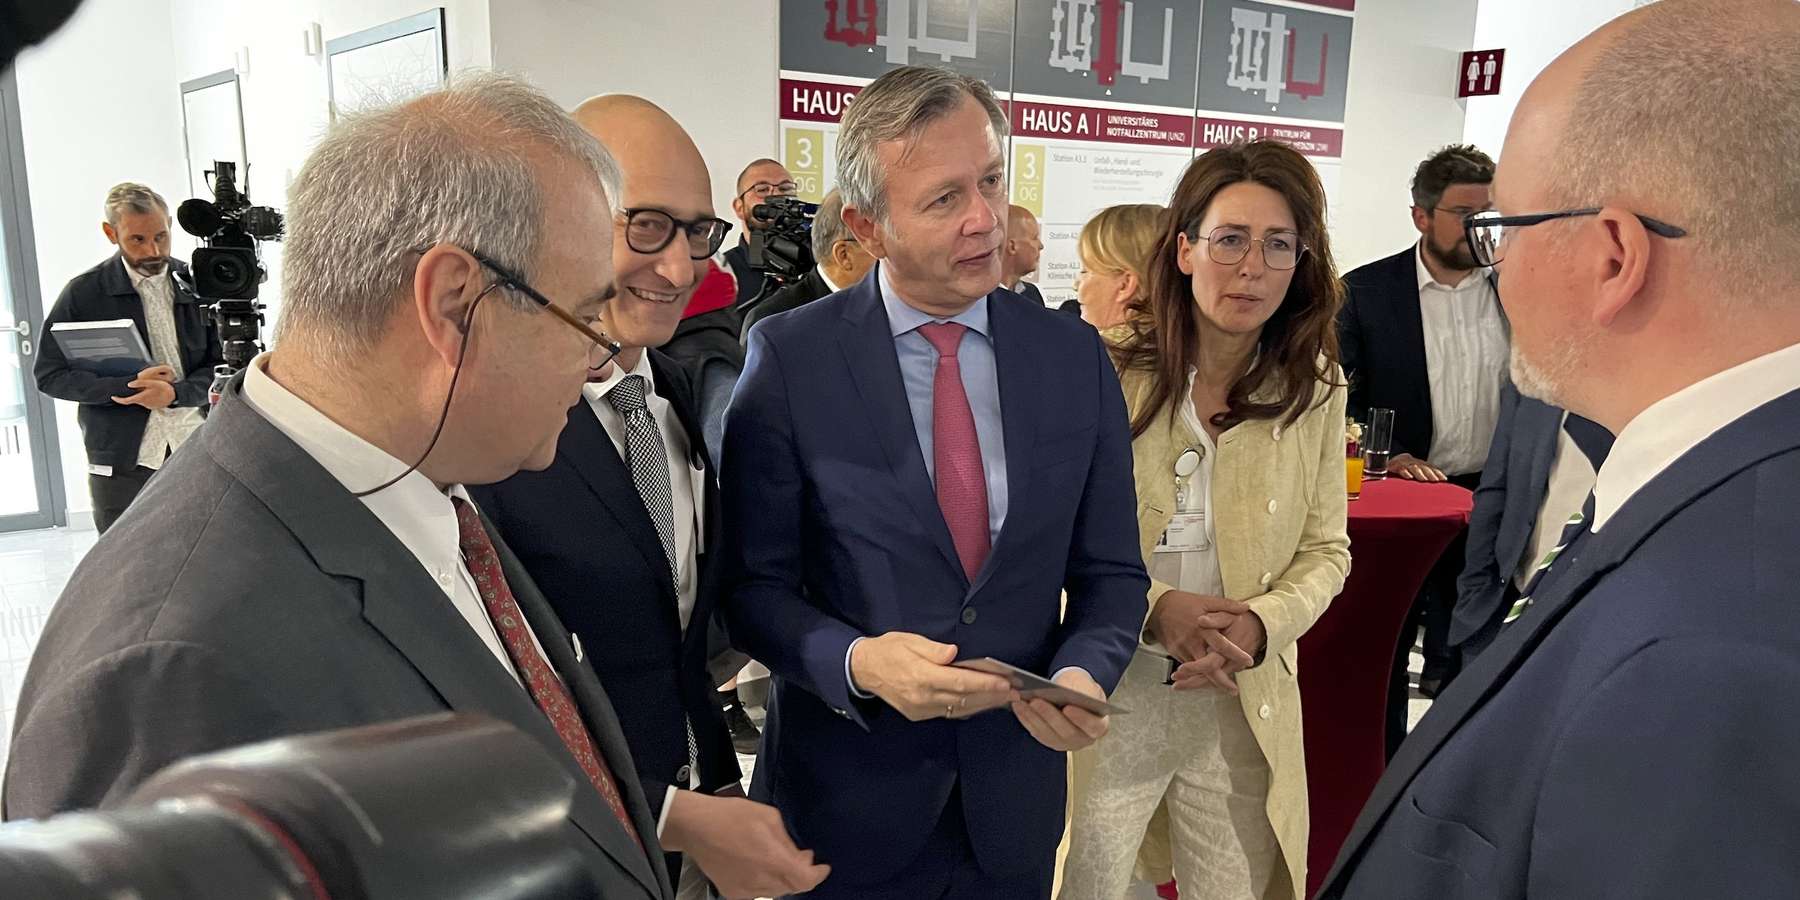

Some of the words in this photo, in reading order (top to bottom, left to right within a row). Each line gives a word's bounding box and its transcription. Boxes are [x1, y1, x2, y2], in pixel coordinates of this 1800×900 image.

[1022, 108, 1073, 134] HAUS
[1076, 113, 1089, 134] A
[1106, 127, 1167, 140] NOTFALLZENTRUM
[1203, 123, 1245, 144] HAUS
[1019, 187, 1037, 200] OG
